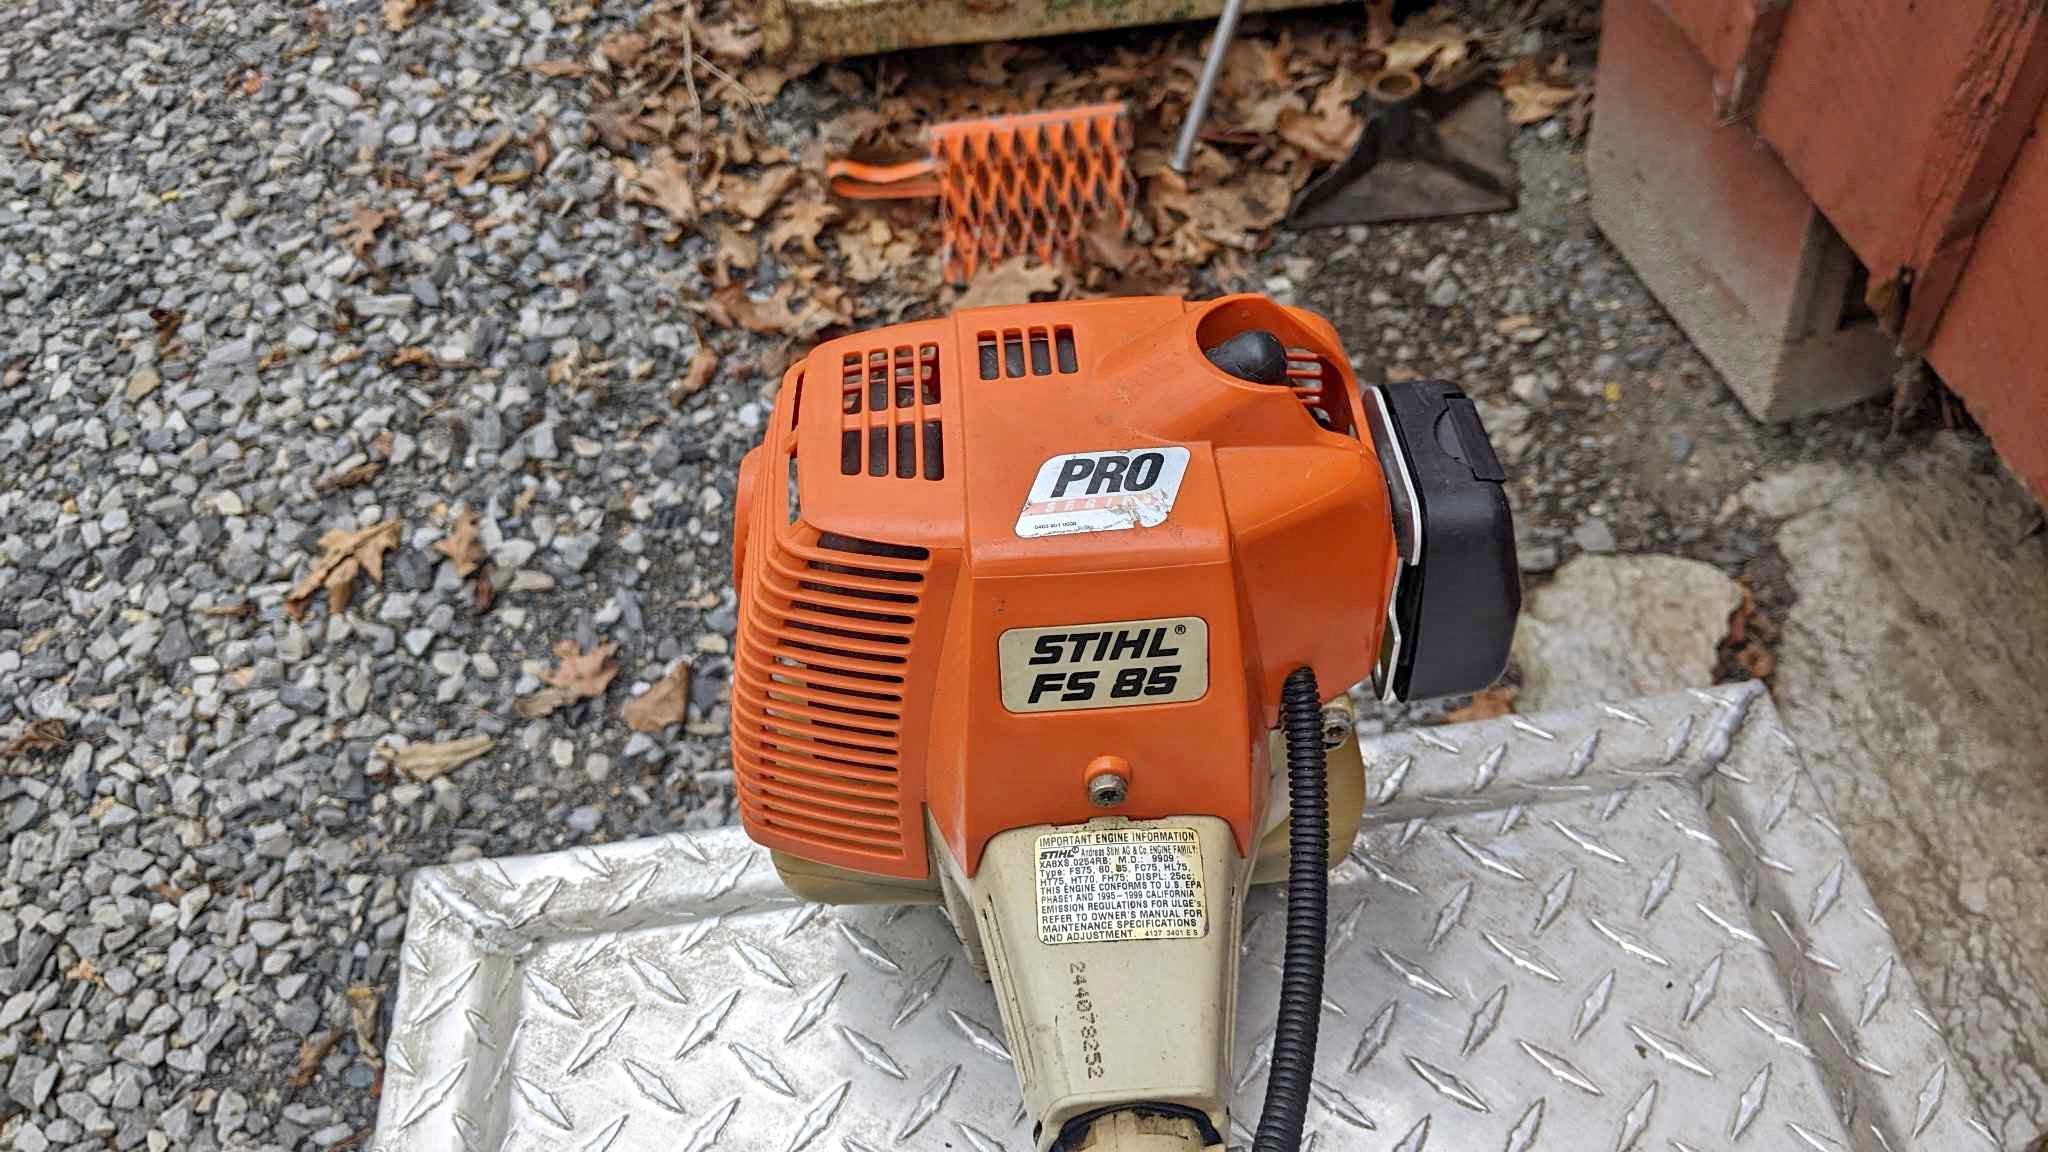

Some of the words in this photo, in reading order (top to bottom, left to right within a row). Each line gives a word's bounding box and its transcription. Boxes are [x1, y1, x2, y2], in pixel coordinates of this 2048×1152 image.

[1051, 453, 1164, 498] PRO
[1027, 670, 1100, 704] FS
[1110, 665, 1182, 698] 85
[1040, 834, 1092, 847] IMPORTANT
[1096, 832, 1128, 844] ENGINE
[1132, 831, 1194, 842] INFORMATION
[1122, 845, 1131, 855] AG
[1133, 845, 1138, 855] &
[1149, 844, 1172, 855] ENGINE
[1173, 844, 1199, 855] FAMILY:
[1040, 869, 1065, 880] Type:
[1069, 865, 1096, 875] FS75,
[1098, 865, 1114, 874] 80,
[1163, 862, 1191, 872] HL75,
[1040, 877, 1067, 887] HT75,
[1070, 875, 1098, 885] HT70,
[1135, 872, 1167, 881] DISPL:
[1040, 886, 1060, 895] THIS
[1063, 884, 1096, 894] ENGINE
[1098, 882, 1148, 892] CONFORMS
[1150, 881, 1161, 889] TO
[1164, 880, 1183, 889] U.S.
[1185, 880, 1202, 889] EPA
[1041, 894, 1073, 905] PHASE1
[1075, 892, 1094, 901] AND
[1145, 889, 1195, 899] CALIFORNIA
[1041, 903, 1084, 914] EMISSION
[1087, 900, 1148, 911] REGULATIONS
[1151, 899, 1169, 908] FOR
[1042, 914, 1073, 924] REFER
[1075, 913, 1088, 922] TO
[1091, 911, 1137, 921] OWNER'S
[1139, 909, 1180, 919] MANUAL
[1183, 909, 1203, 918] FOR
[1042, 920, 1113, 933] MAINTENANCE
[1116, 919, 1197, 929] SPECIFICATIONS
[1043, 933, 1063, 943] AND
[1066, 929, 1137, 941] ADJUSTMENT.
[1070, 961, 1104, 1080] 244078252
